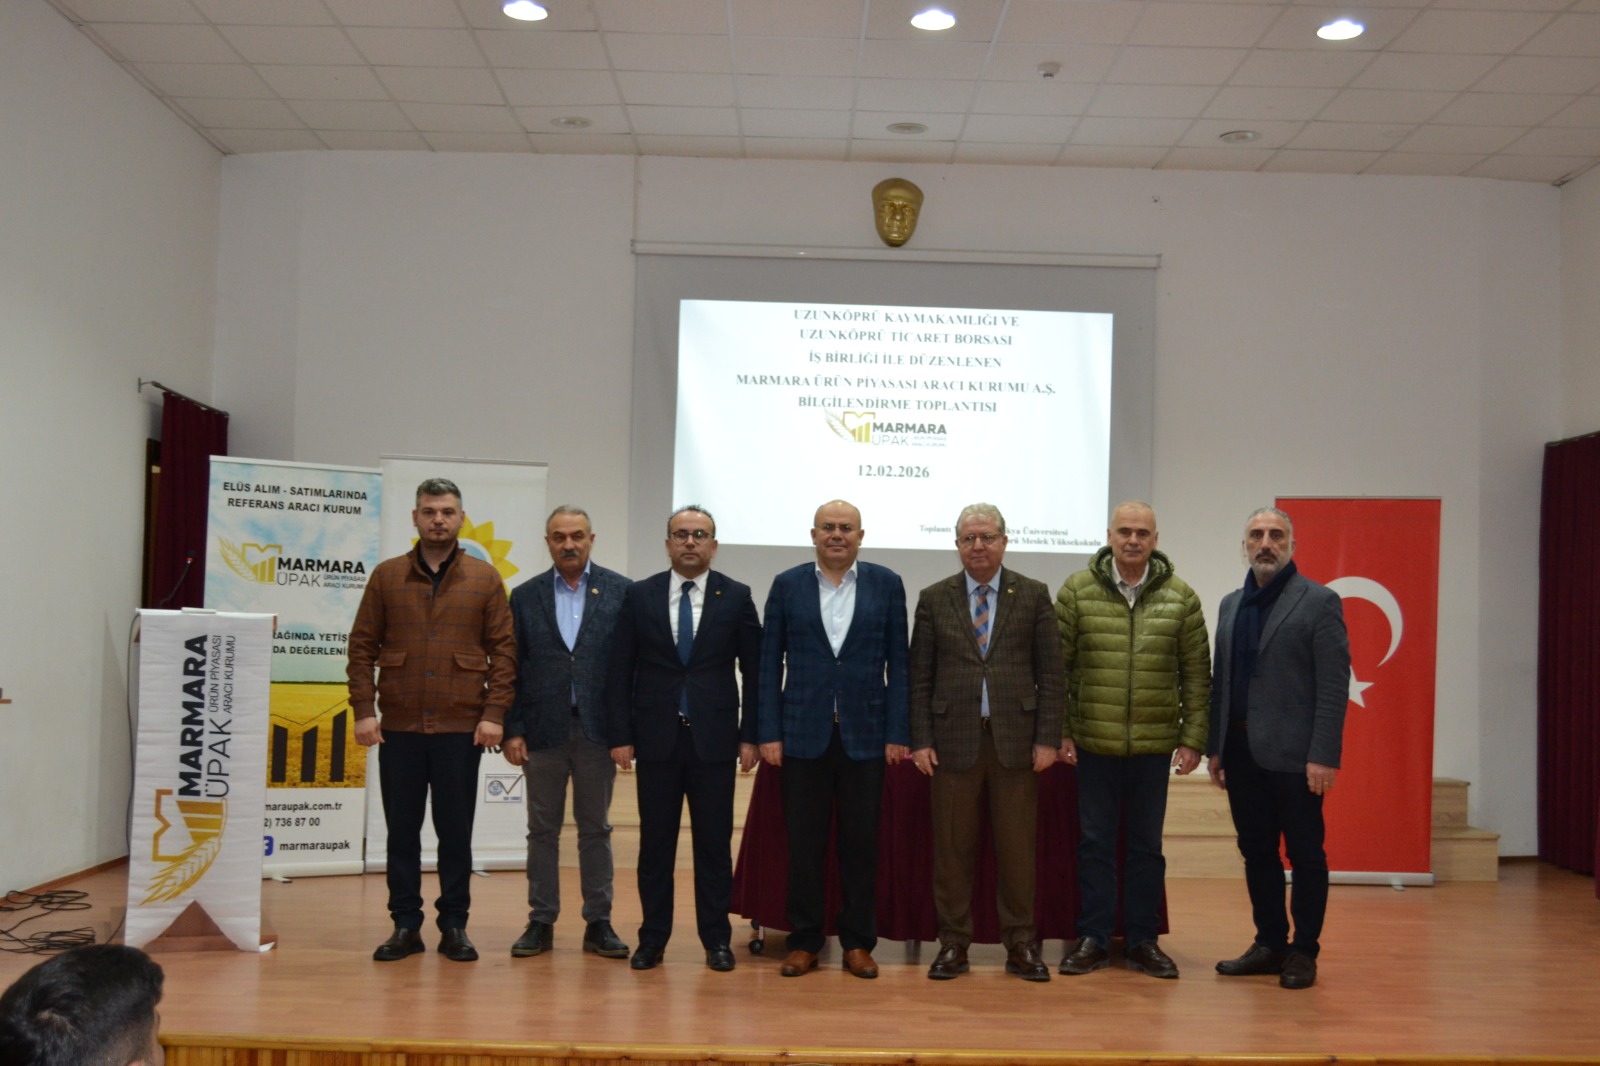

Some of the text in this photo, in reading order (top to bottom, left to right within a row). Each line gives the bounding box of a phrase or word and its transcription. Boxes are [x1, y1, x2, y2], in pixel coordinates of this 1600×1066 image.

[794, 308, 1020, 327] UZUNKÖPRÜ KAYMAKAMLIĞI VE
[800, 328, 1012, 346] UZUNKÖPRÜ TİCARET BORSASI
[810, 350, 1002, 368] İŞ BİRLİĞİ İLE DÜZENLENEN
[736, 374, 1056, 396] MARMARA ÜRÜN PİYASASI ARACI KURUMU A.Ş.
[798, 395, 997, 412] BİLGİLENDİRME TOPLANTISI
[872, 422, 947, 434] MARMARA
[858, 464, 930, 478] 12.02.2026
[223, 481, 251, 492] ELÜS
[254, 484, 280, 494] ALIM
[290, 486, 368, 500] SATIMLARINDA
[228, 498, 362, 515] REFERANS ARACI KURUM
[1006, 528, 1020, 536] kya
[1023, 526, 1068, 536] Üniversitesi
[278, 557, 365, 574] MARMARA
[277, 572, 321, 587] ÜPAK
[319, 632, 348, 643] YETİŞ
[290, 645, 346, 656] DEĞERLENİ
[223, 635, 236, 714] ARACI KURUMU
[178, 634, 208, 797] MARMARA
[205, 635, 232, 798] ÜPAK ÜRÜN PİYASASI
[265, 802, 342, 812] maraupak.com.tr
[275, 818, 292, 827] 736
[295, 818, 306, 826] 87
[309, 817, 320, 826] 00
[280, 840, 350, 851] marmaraupak
